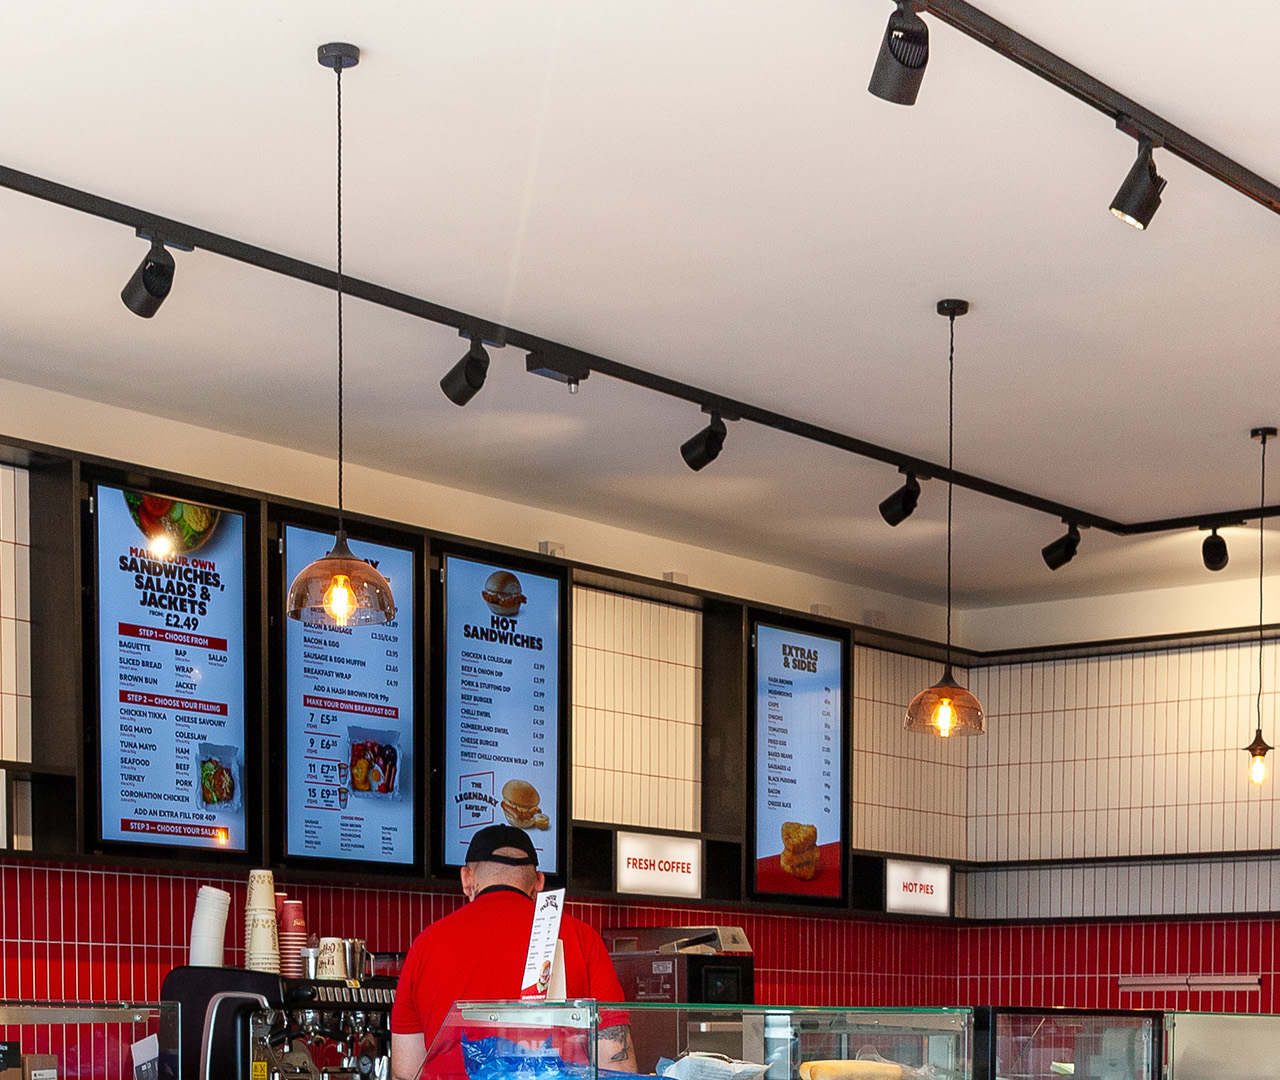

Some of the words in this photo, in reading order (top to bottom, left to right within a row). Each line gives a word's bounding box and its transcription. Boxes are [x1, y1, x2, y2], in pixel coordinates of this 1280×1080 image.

[191, 558, 215, 571] OWN
[119, 556, 225, 591] SANDWICHES,
[135, 574, 196, 599] SALADS
[200, 586, 211, 602] &
[140, 591, 207, 616] JACKETS
[165, 614, 199, 631] £2.49
[491, 615, 517, 632] HOT
[139, 628, 154, 638] STEP
[165, 633, 191, 644] CHOOSE
[191, 637, 209, 646] FROM
[464, 624, 543, 651] SANDWICHES
[119, 640, 151, 651] BAGUETTE
[175, 649, 187, 657] BAP
[208, 654, 227, 663] SALAD
[782, 643, 818, 662] EXTRAS
[119, 657, 140, 666] SLICED
[142, 660, 162, 669] BREAD
[175, 665, 193, 673] WRAP
[783, 657, 790, 668] &
[792, 658, 817, 673] SIDES
[119, 674, 144, 683] BROWN
[145, 677, 158, 685] BUN
[303, 667, 334, 678] BREAKFAST
[335, 672, 351, 680] WRAP
[175, 681, 197, 690] JACKET
[331, 687, 347, 695] HASH
[348, 690, 367, 698] BROWN
[368, 691, 379, 700] FOR
[127, 693, 142, 702] STEP
[154, 697, 179, 707] CHOOSE
[181, 700, 197, 709] YOUR
[199, 703, 220, 712] FILLING
[323, 700, 338, 708] YOUR
[340, 702, 354, 710] OWN
[354, 704, 384, 714] BREAKFAST
[120, 708, 147, 718] CHICKEN
[148, 711, 167, 720] TIKKA
[309, 713, 315, 722] 7
[175, 715, 197, 724] CHEESE
[199, 718, 226, 727] SAVOURY
[120, 724, 133, 732] EGG
[134, 726, 152, 734] MAYO
[175, 731, 207, 741] COLESLAW
[120, 741, 137, 749] TUNA
[139, 742, 157, 751] MAYO
[309, 738, 314, 747] 9
[175, 747, 190, 755] HAM
[120, 757, 150, 766] SEAFOOD
[175, 763, 190, 771] BEEF
[120, 773, 145, 782] TURKEY
[176, 779, 193, 787] PORK
[121, 790, 162, 800] CORONATION
[163, 793, 189, 802] CHICKEN
[454, 791, 499, 807] LEGENDARY
[158, 810, 178, 818] EXTRA
[130, 822, 146, 830] STEP
[156, 825, 182, 833] CHOOSE
[627, 857, 655, 871] FRESH
[658, 860, 691, 874] COFFEE
[903, 881, 918, 893] HOT
[919, 884, 934, 895] PIES
